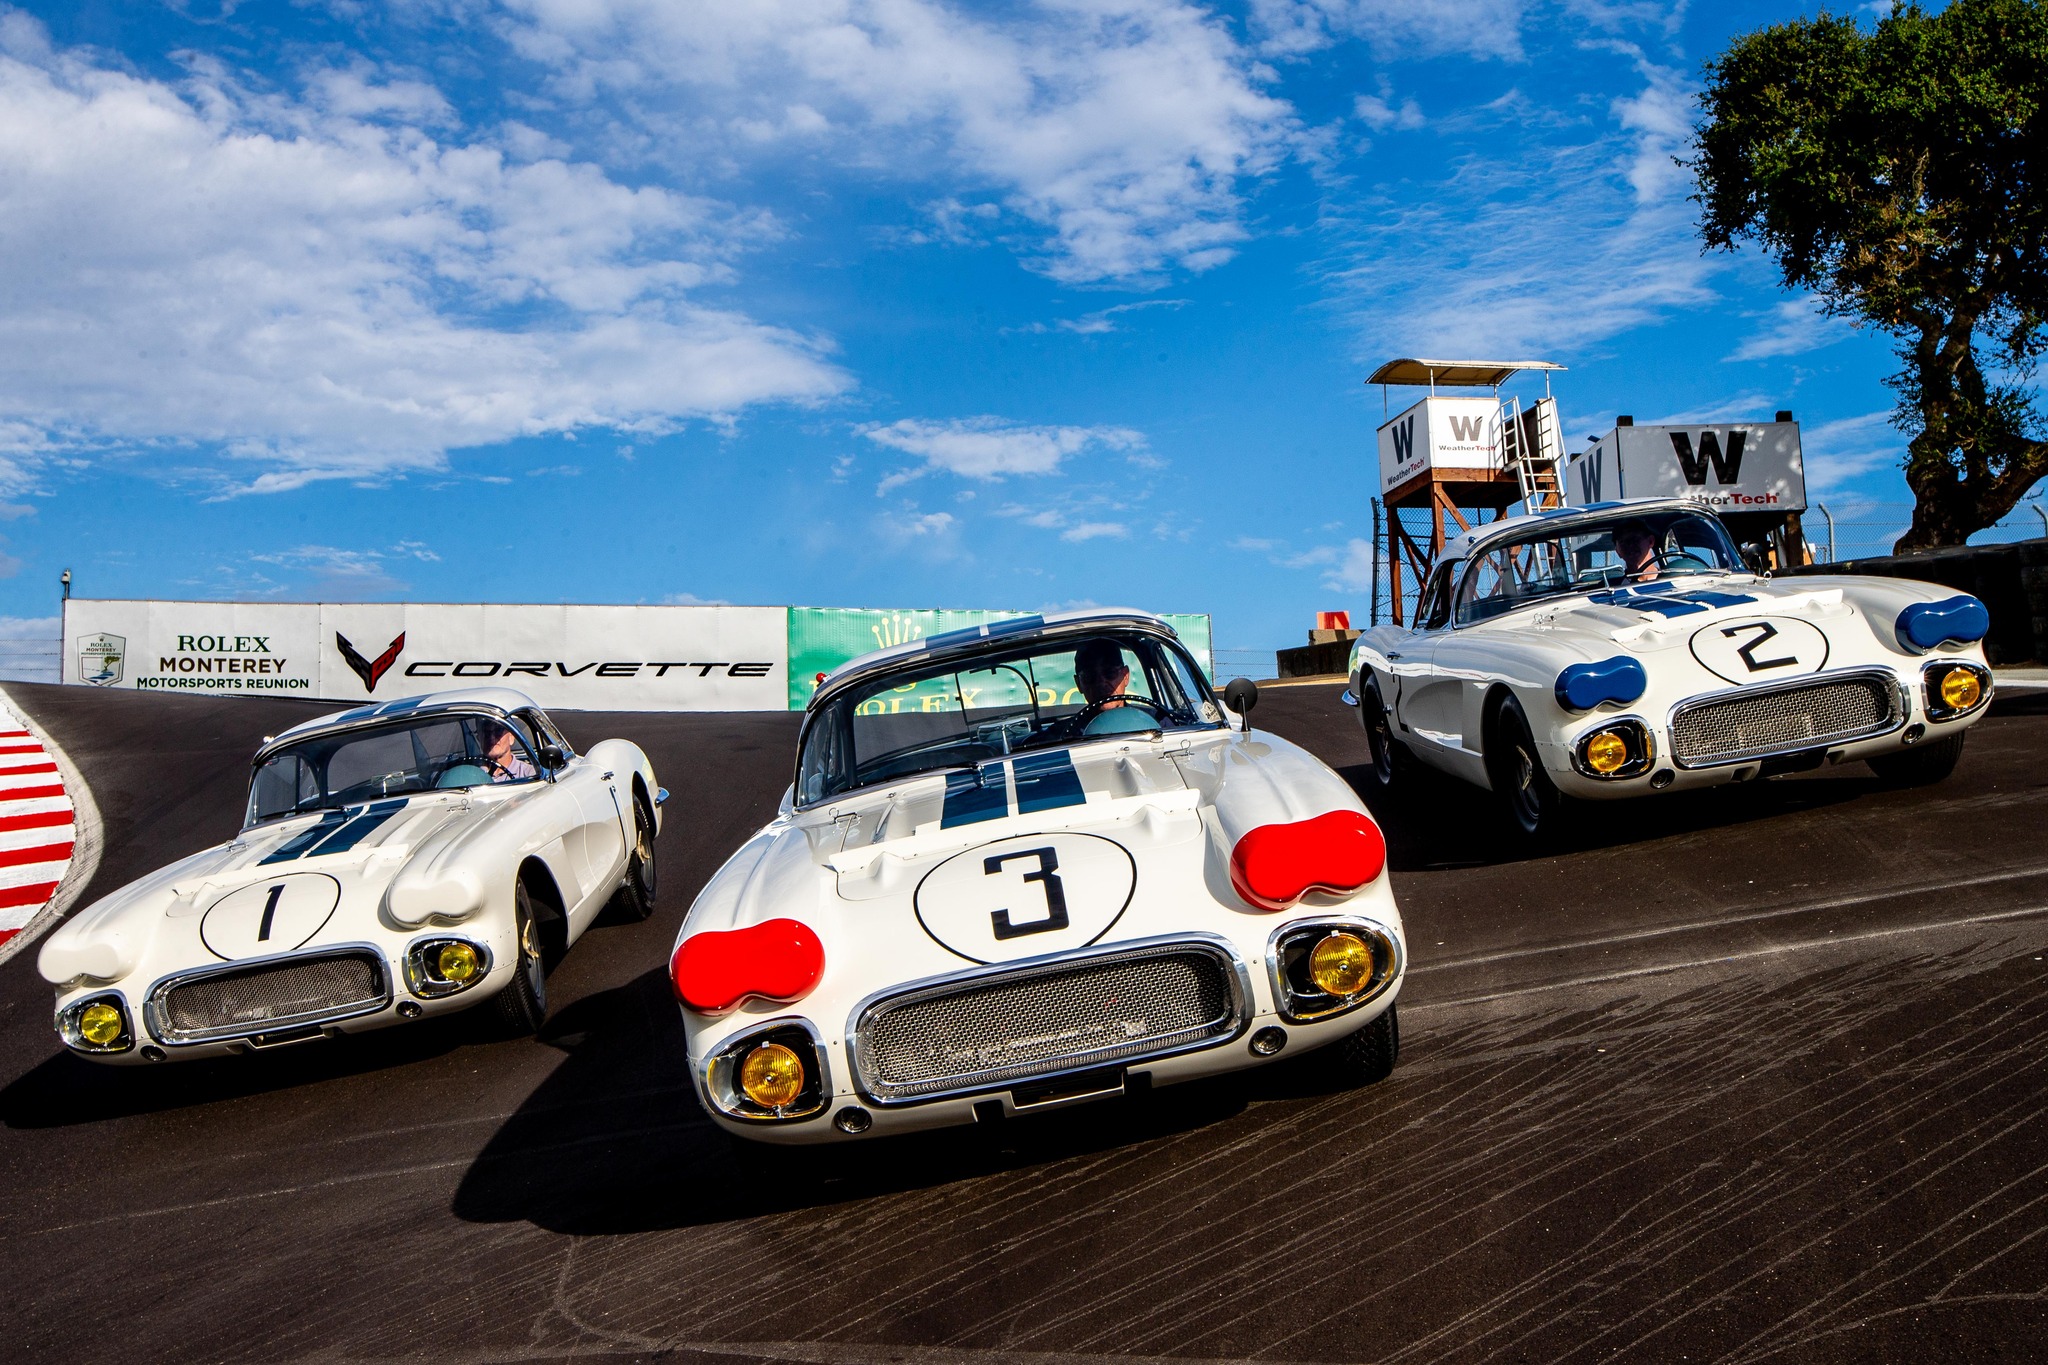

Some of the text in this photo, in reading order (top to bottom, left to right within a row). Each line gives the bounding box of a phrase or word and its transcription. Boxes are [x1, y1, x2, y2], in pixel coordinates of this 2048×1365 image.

[1392, 413, 1414, 465] W
[1449, 415, 1483, 441] W
[1387, 458, 1425, 486] WeatherTech
[1580, 446, 1602, 504] W
[1668, 430, 1748, 485] W
[177, 635, 271, 652] ROLEX
[1720, 621, 1799, 673] 2
[137, 677, 309, 690] MOTORSPORTS REUNION
[160, 657, 287, 674] MONTEREY
[404, 662, 774, 677] CORVETTE
[258, 884, 286, 942] 1
[983, 846, 1070, 941] 3
